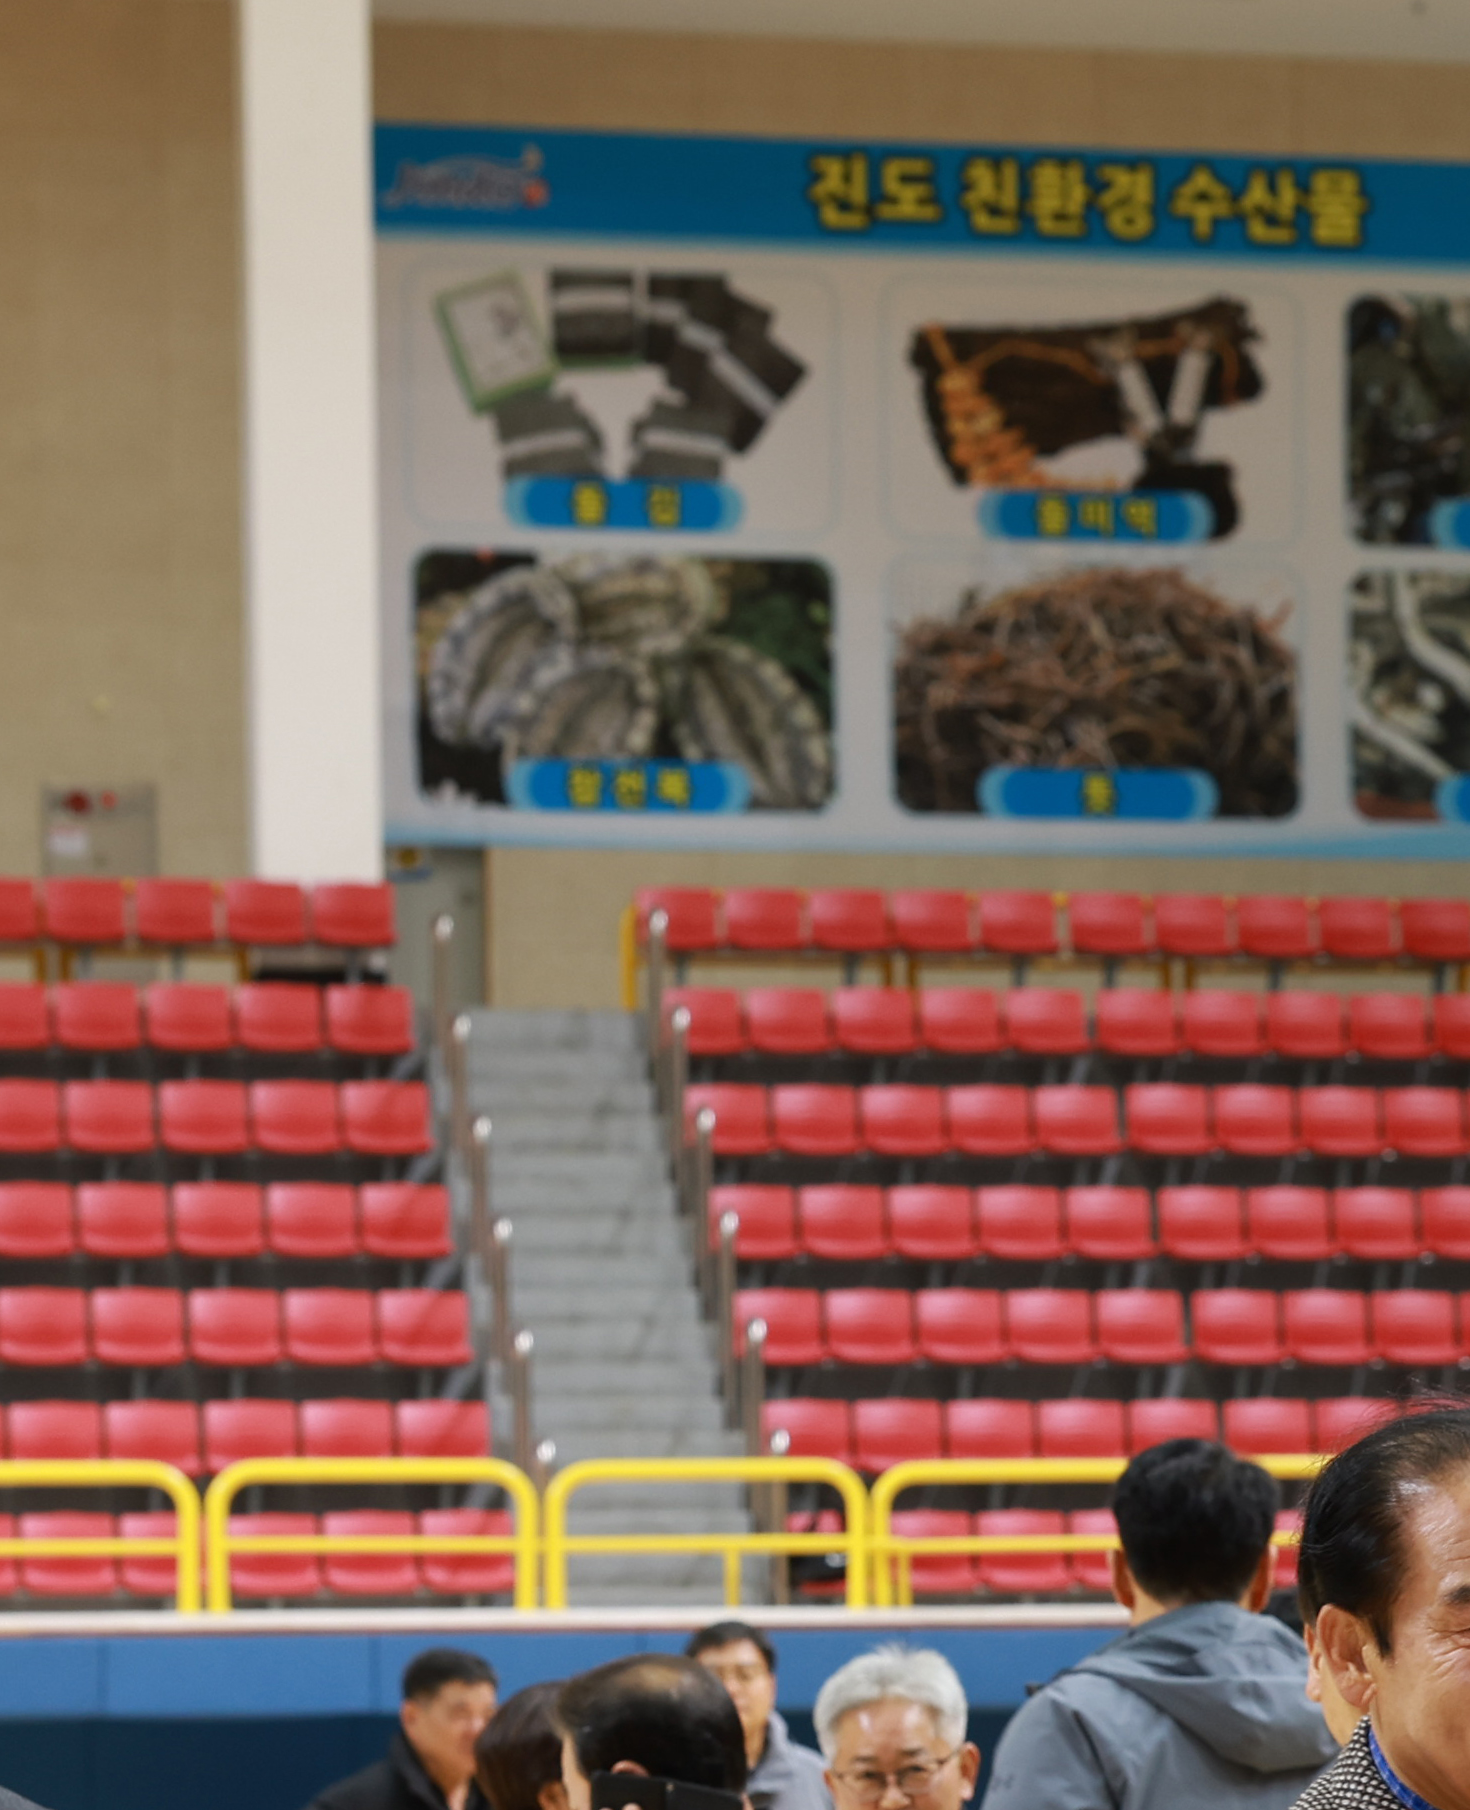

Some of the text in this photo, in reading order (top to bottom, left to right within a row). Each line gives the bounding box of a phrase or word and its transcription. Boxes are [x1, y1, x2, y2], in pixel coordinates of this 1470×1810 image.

[808, 152, 1370, 248] 진도 친환경 수산물
